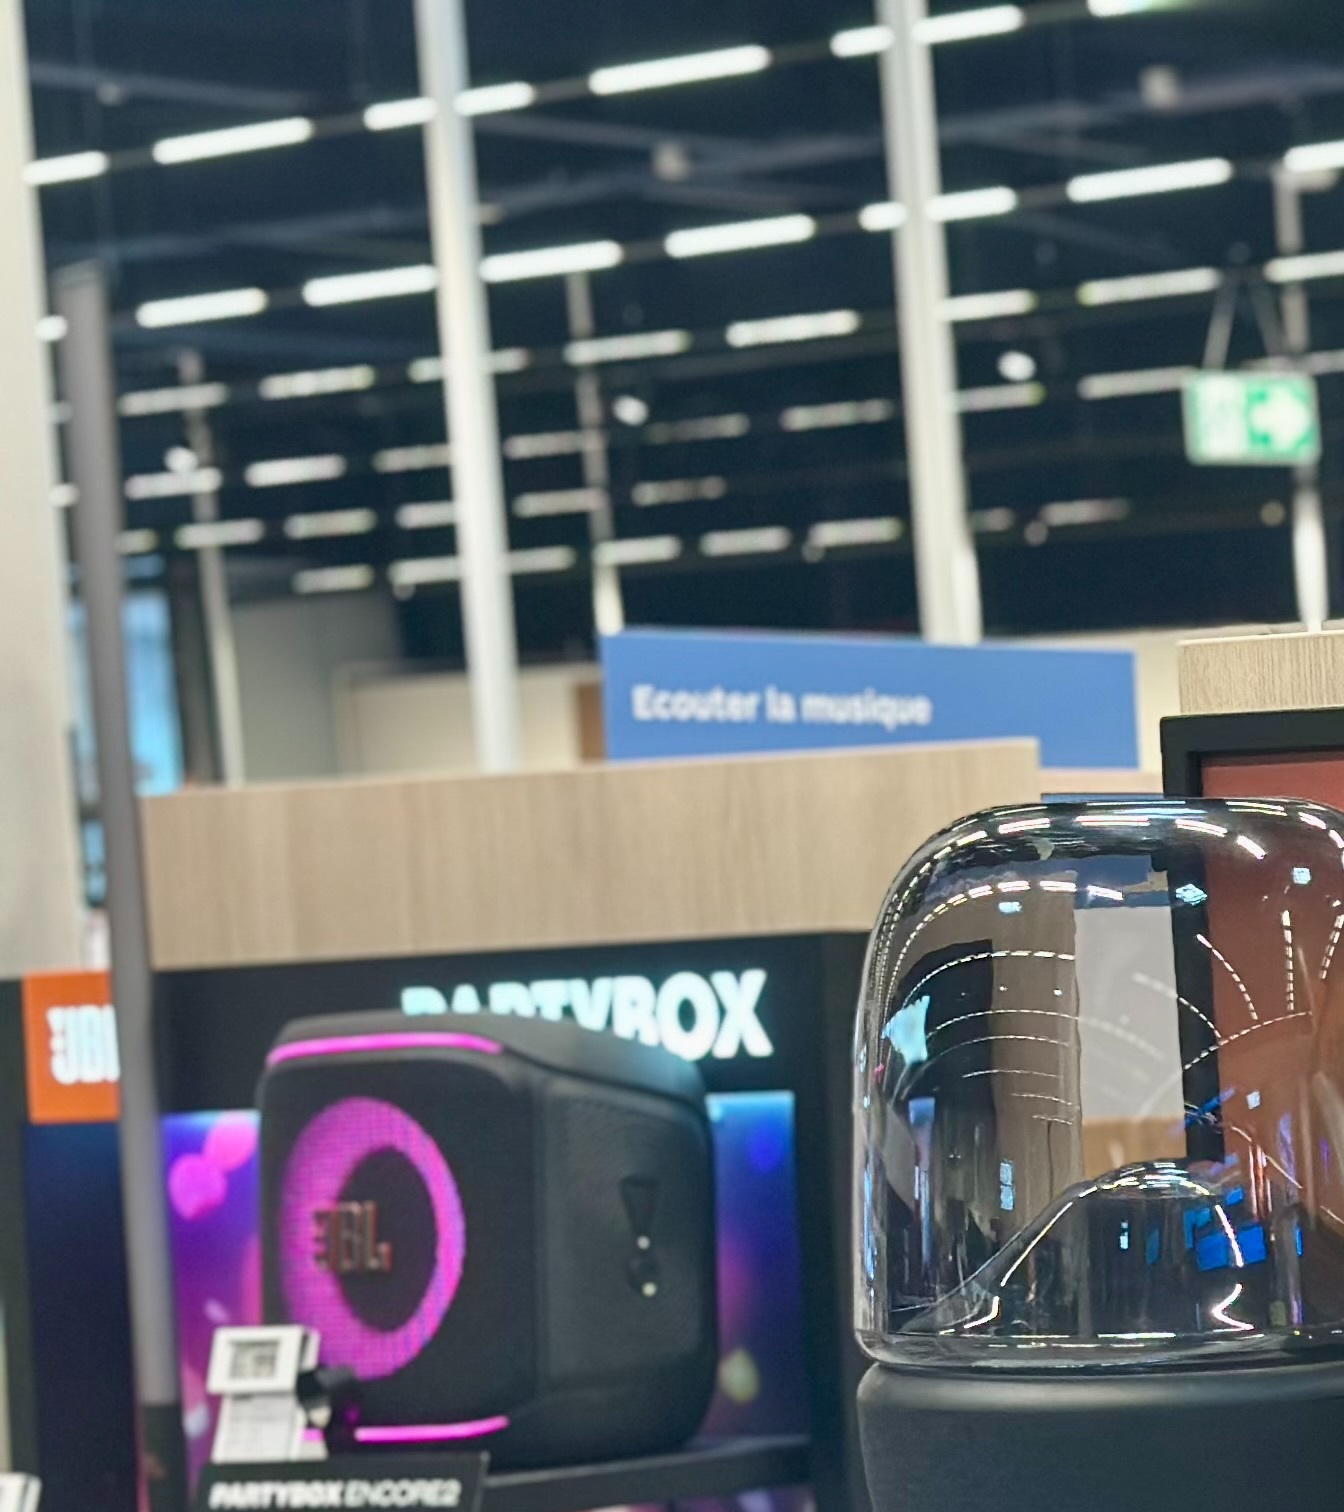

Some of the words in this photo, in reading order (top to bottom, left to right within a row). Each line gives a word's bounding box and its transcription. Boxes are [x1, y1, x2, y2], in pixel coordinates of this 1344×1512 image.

[631, 684, 760, 722] Ecouter
[764, 685, 797, 723] la
[802, 687, 933, 731] musique
